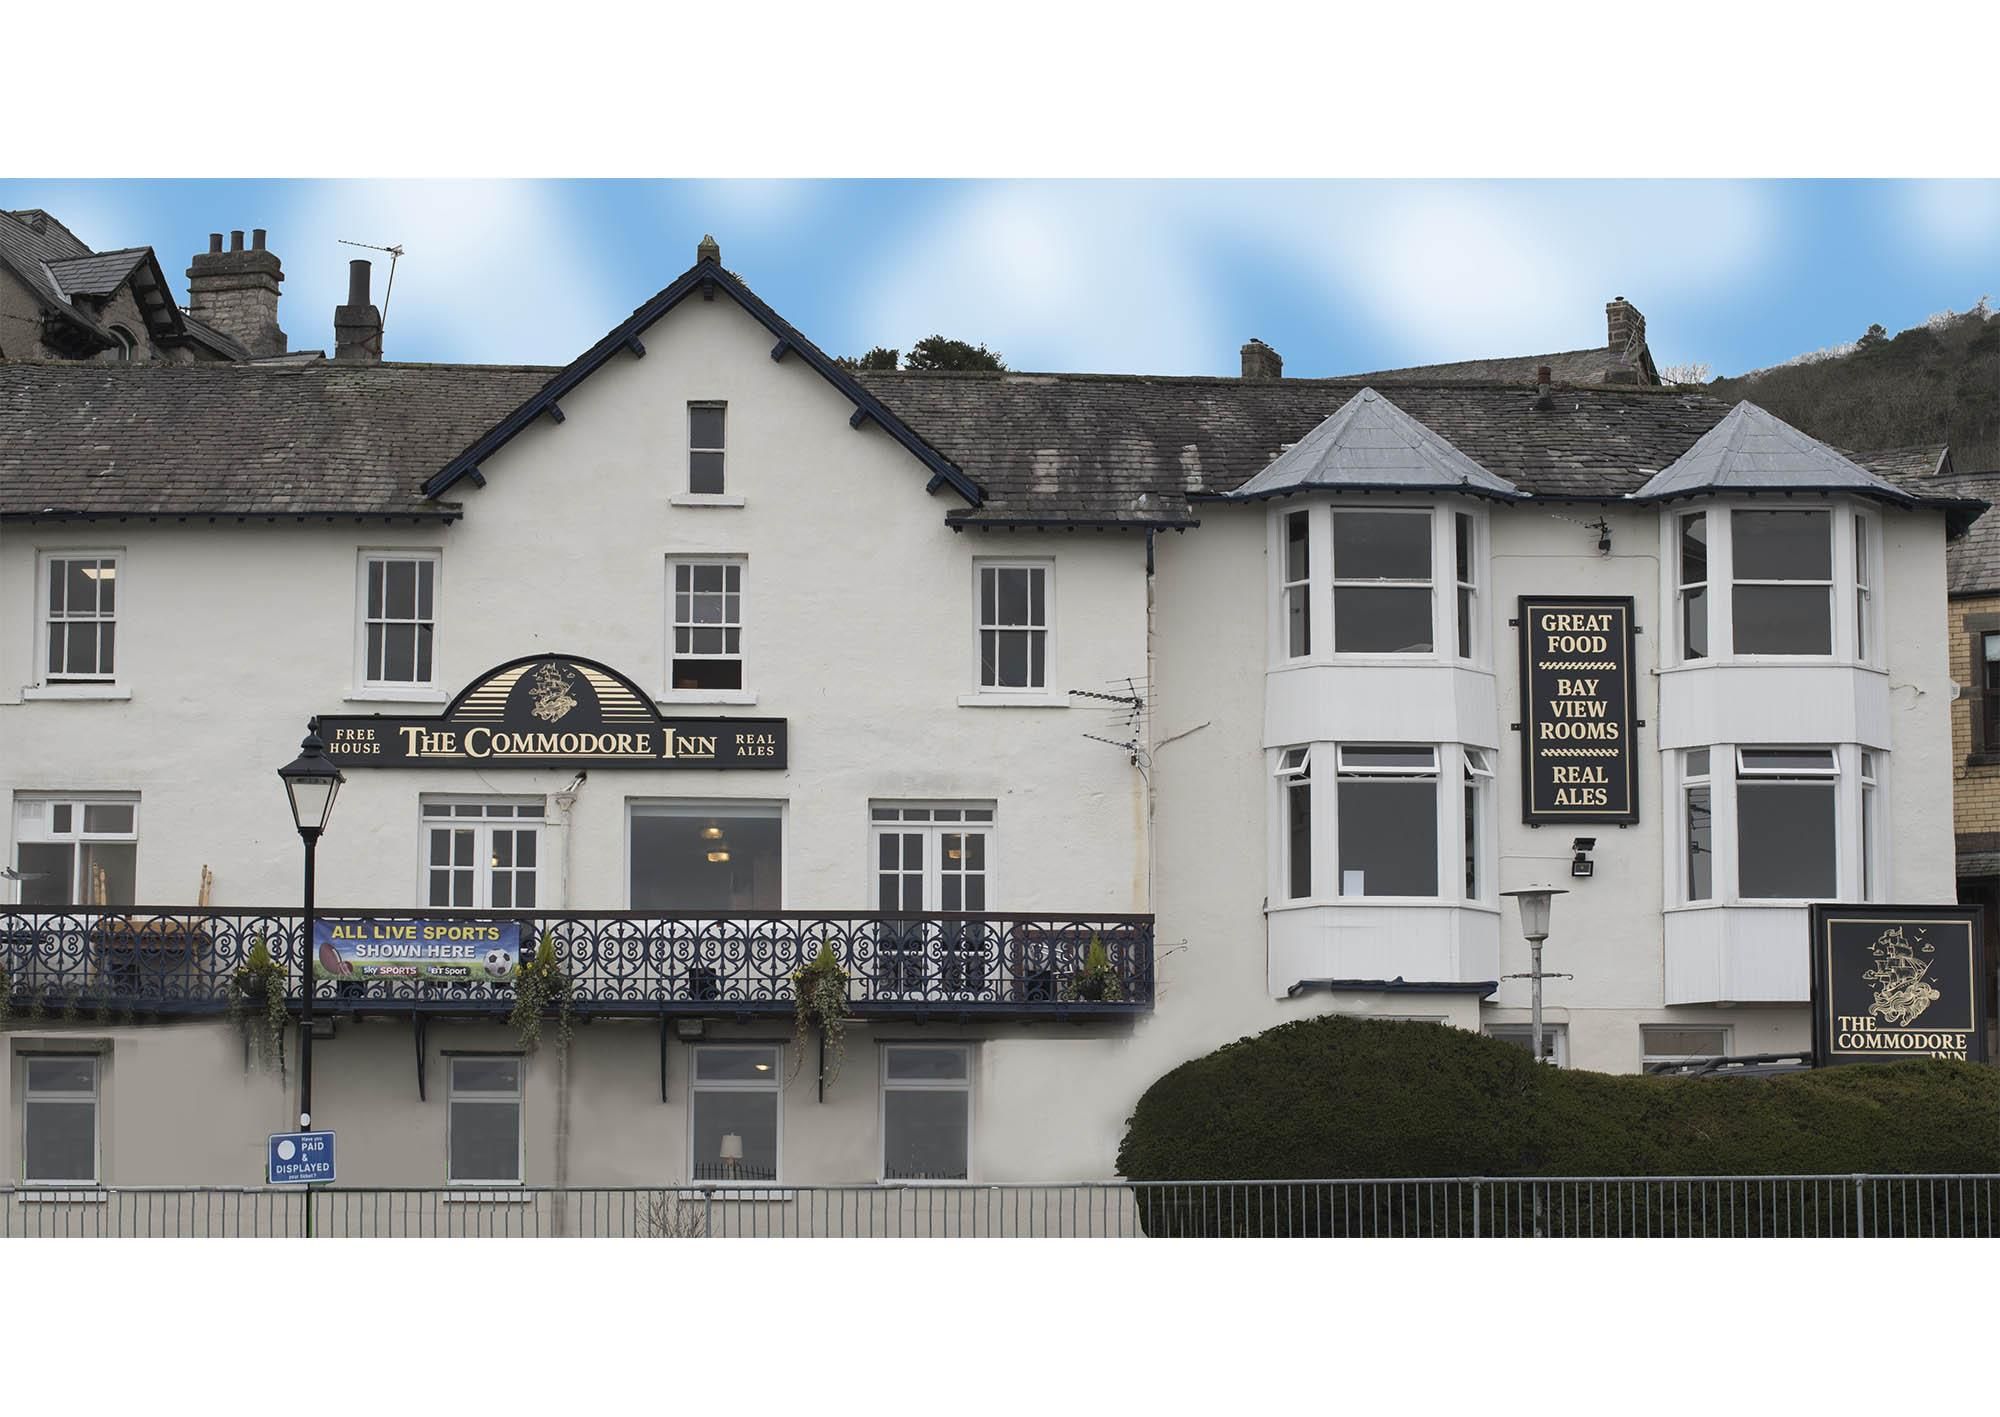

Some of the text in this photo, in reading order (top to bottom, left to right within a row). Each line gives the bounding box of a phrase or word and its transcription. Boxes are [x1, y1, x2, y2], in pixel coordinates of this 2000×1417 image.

[1541, 614, 1612, 631] GREAT
[1547, 636, 1607, 653] FOOD
[1557, 679, 1599, 696] BAY
[1550, 701, 1607, 718] VIEW
[335, 729, 375, 740] FREE
[735, 733, 776, 744] REAL
[1540, 722, 1619, 740] ROOMS
[330, 742, 381, 754] HOUSE
[400, 726, 716, 758] THE COMMODORE INN
[737, 745, 775, 757] ALES
[1552, 766, 1608, 783] REAL
[1554, 788, 1608, 805] ALES
[331, 925, 500, 940] ALL LIVE SPORTS
[356, 944, 475, 958] SHOWN HERE
[363, 966, 417, 975] sky SPORTS
[430, 966, 467, 976] BT Sport
[1838, 1016, 1877, 1032] THE
[1838, 1034, 1967, 1049] COMMODORE
[301, 1142, 324, 1151] PAID
[301, 1153, 308, 1161] &
[276, 1162, 330, 1174] DISPLAYED
